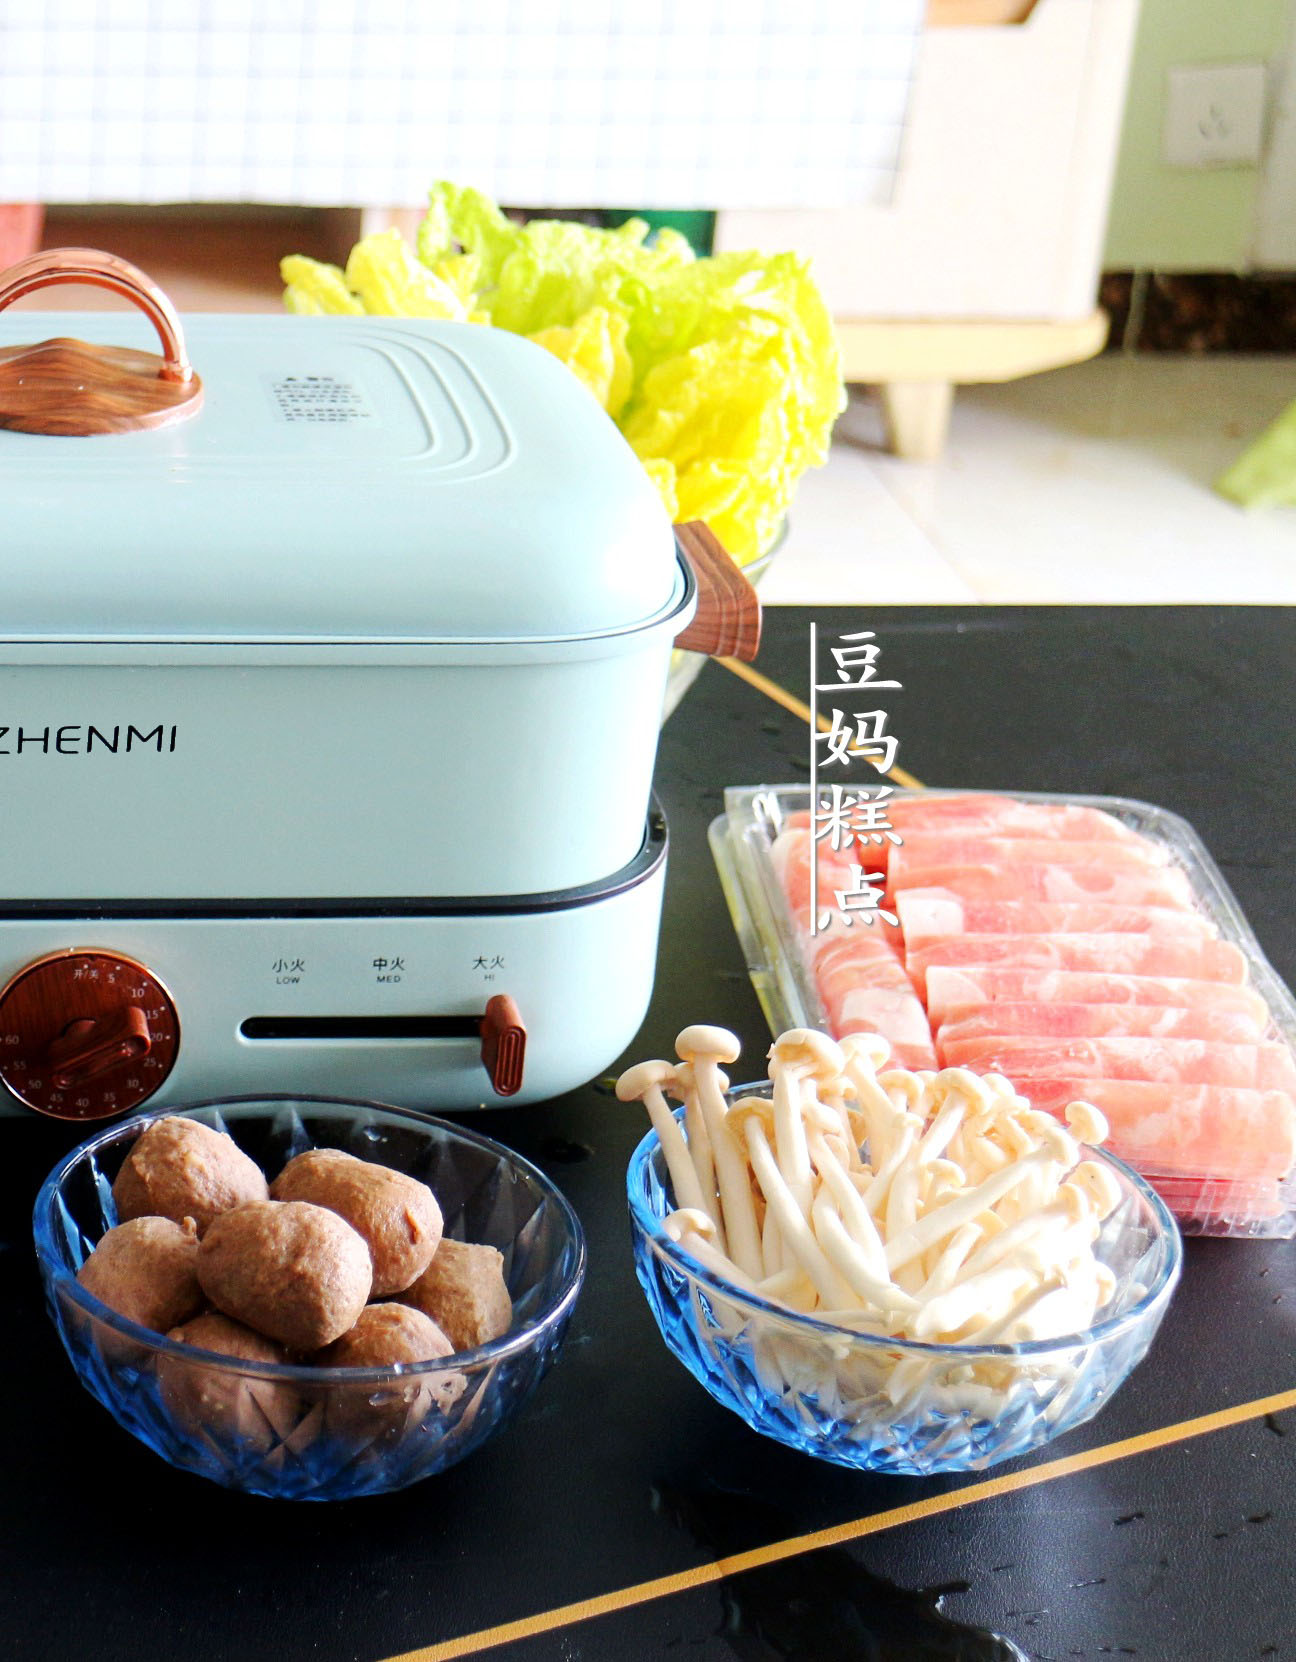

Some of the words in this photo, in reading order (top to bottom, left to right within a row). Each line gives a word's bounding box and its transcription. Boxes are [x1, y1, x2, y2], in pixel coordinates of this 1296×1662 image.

[272, 958, 305, 973] 小火
[372, 957, 405, 972] 中火
[472, 955, 505, 970] 大火
[108, 973, 116, 984] 5
[275, 976, 301, 985] LOW
[376, 975, 402, 983] MED
[484, 973, 496, 981] HI
[131, 988, 144, 998] 10
[147, 1010, 159, 1020] 15
[150, 1032, 163, 1041] 20
[144, 1057, 157, 1067] 25
